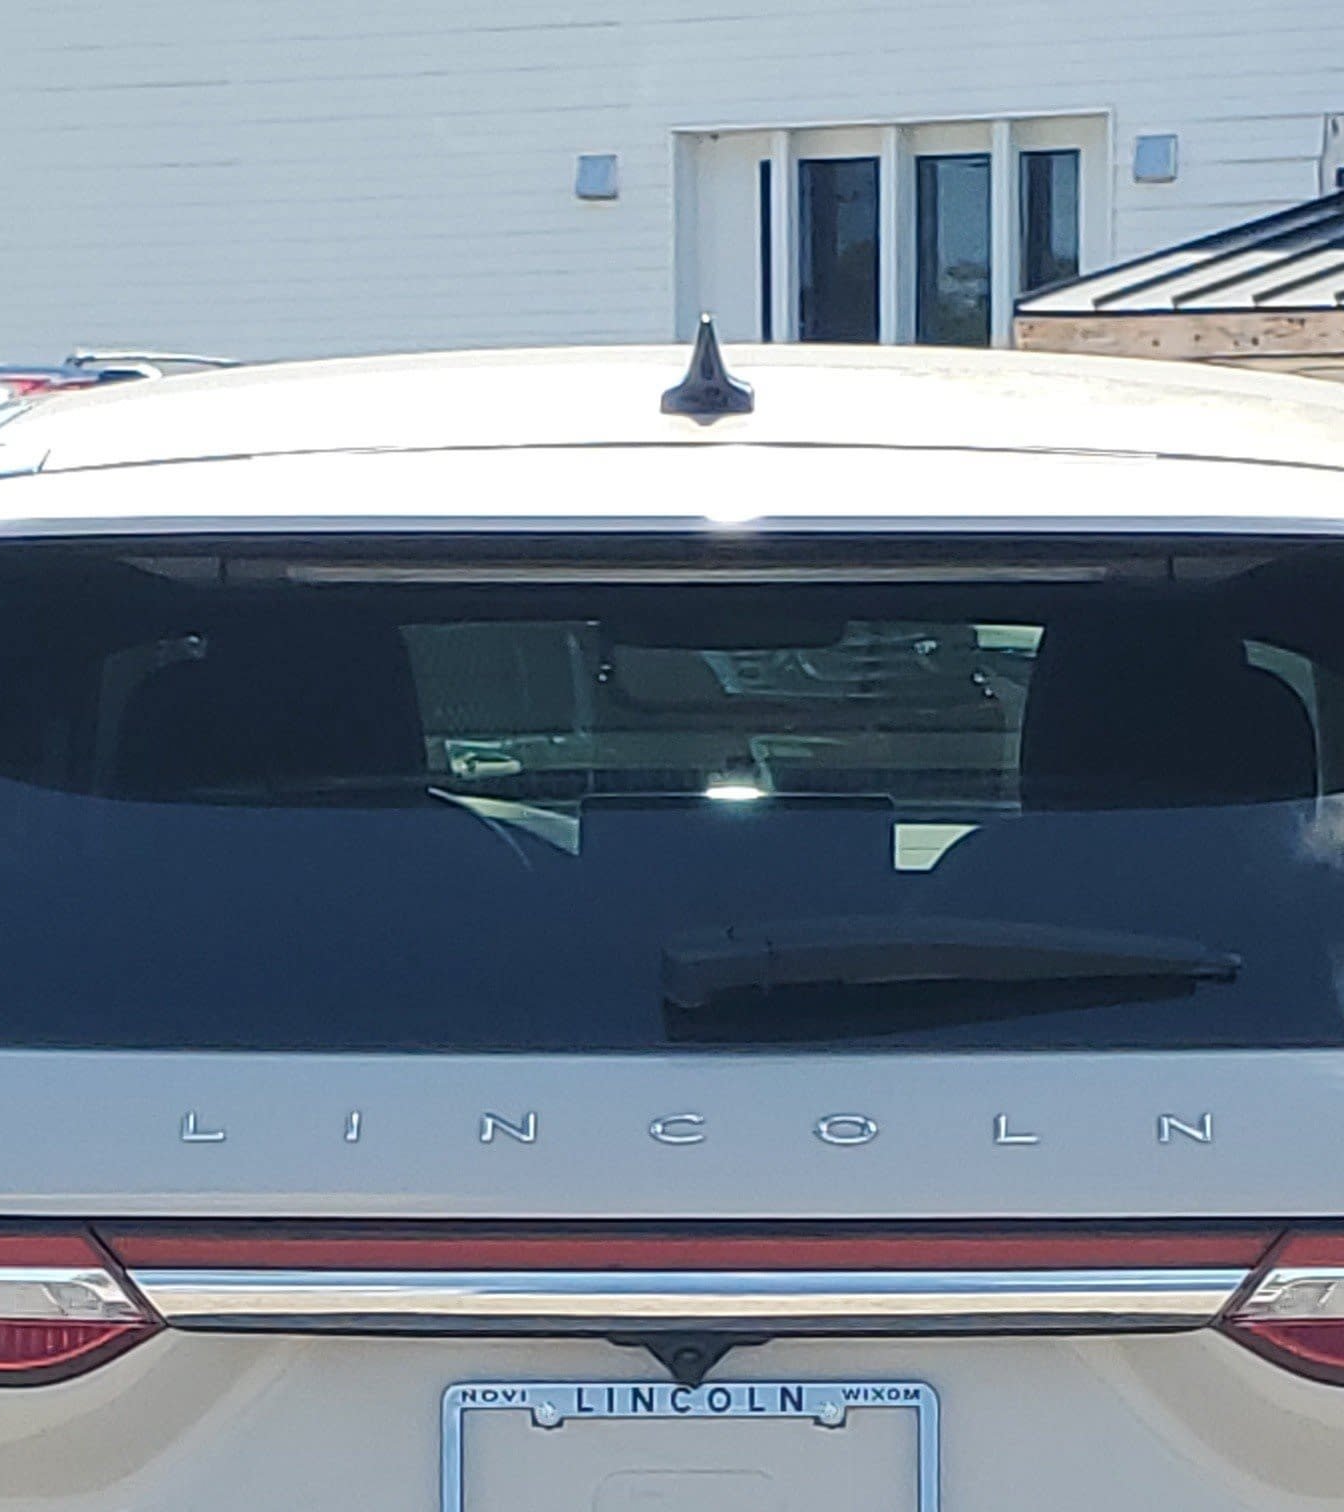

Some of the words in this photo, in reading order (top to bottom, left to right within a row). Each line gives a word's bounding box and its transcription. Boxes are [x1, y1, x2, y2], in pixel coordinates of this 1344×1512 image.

[181, 1110, 1213, 1144] LINCOLN
[461, 1390, 527, 1403] NOVI
[576, 1386, 804, 1414] LINCOLN
[841, 1388, 921, 1402] WIXOM
